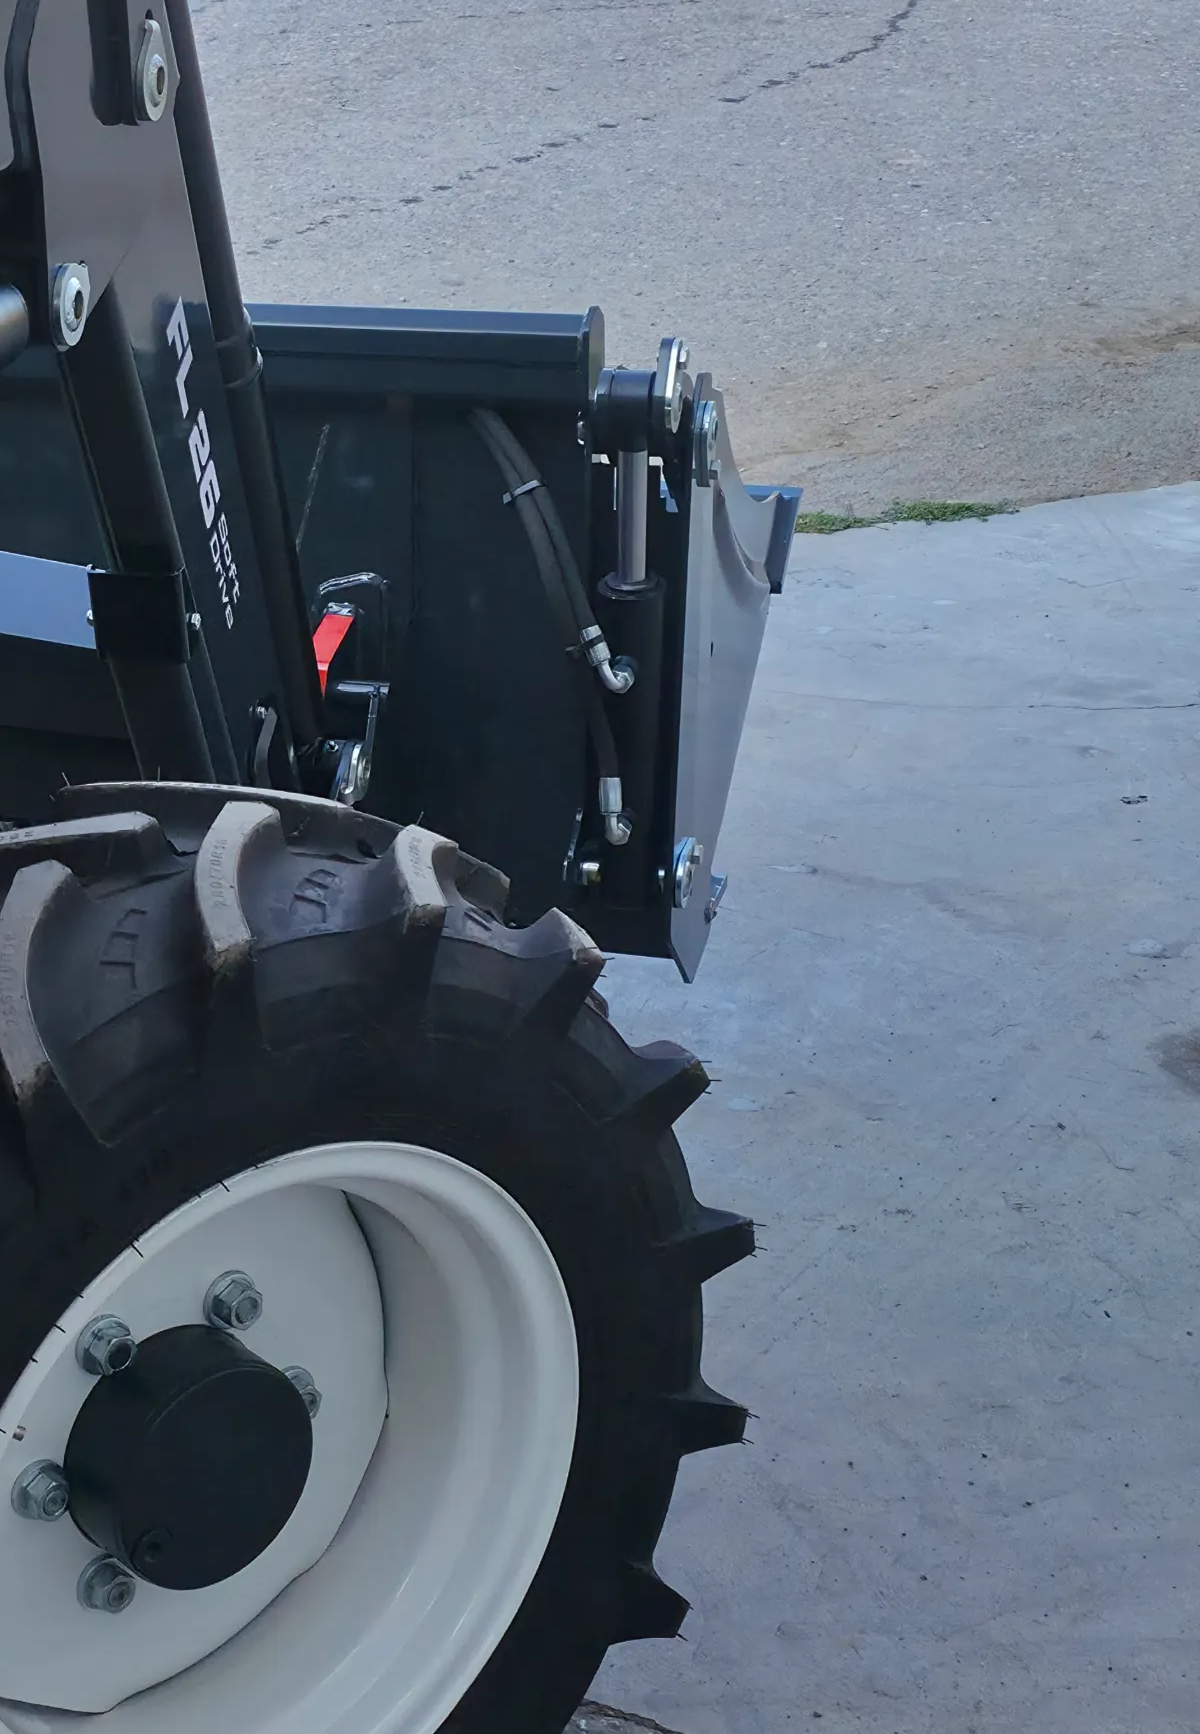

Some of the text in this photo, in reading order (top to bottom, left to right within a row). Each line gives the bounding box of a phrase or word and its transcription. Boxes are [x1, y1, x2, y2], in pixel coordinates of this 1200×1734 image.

[166, 296, 220, 528] FL 26
[208, 531, 234, 630] Drive
[217, 512, 241, 604] Soft
